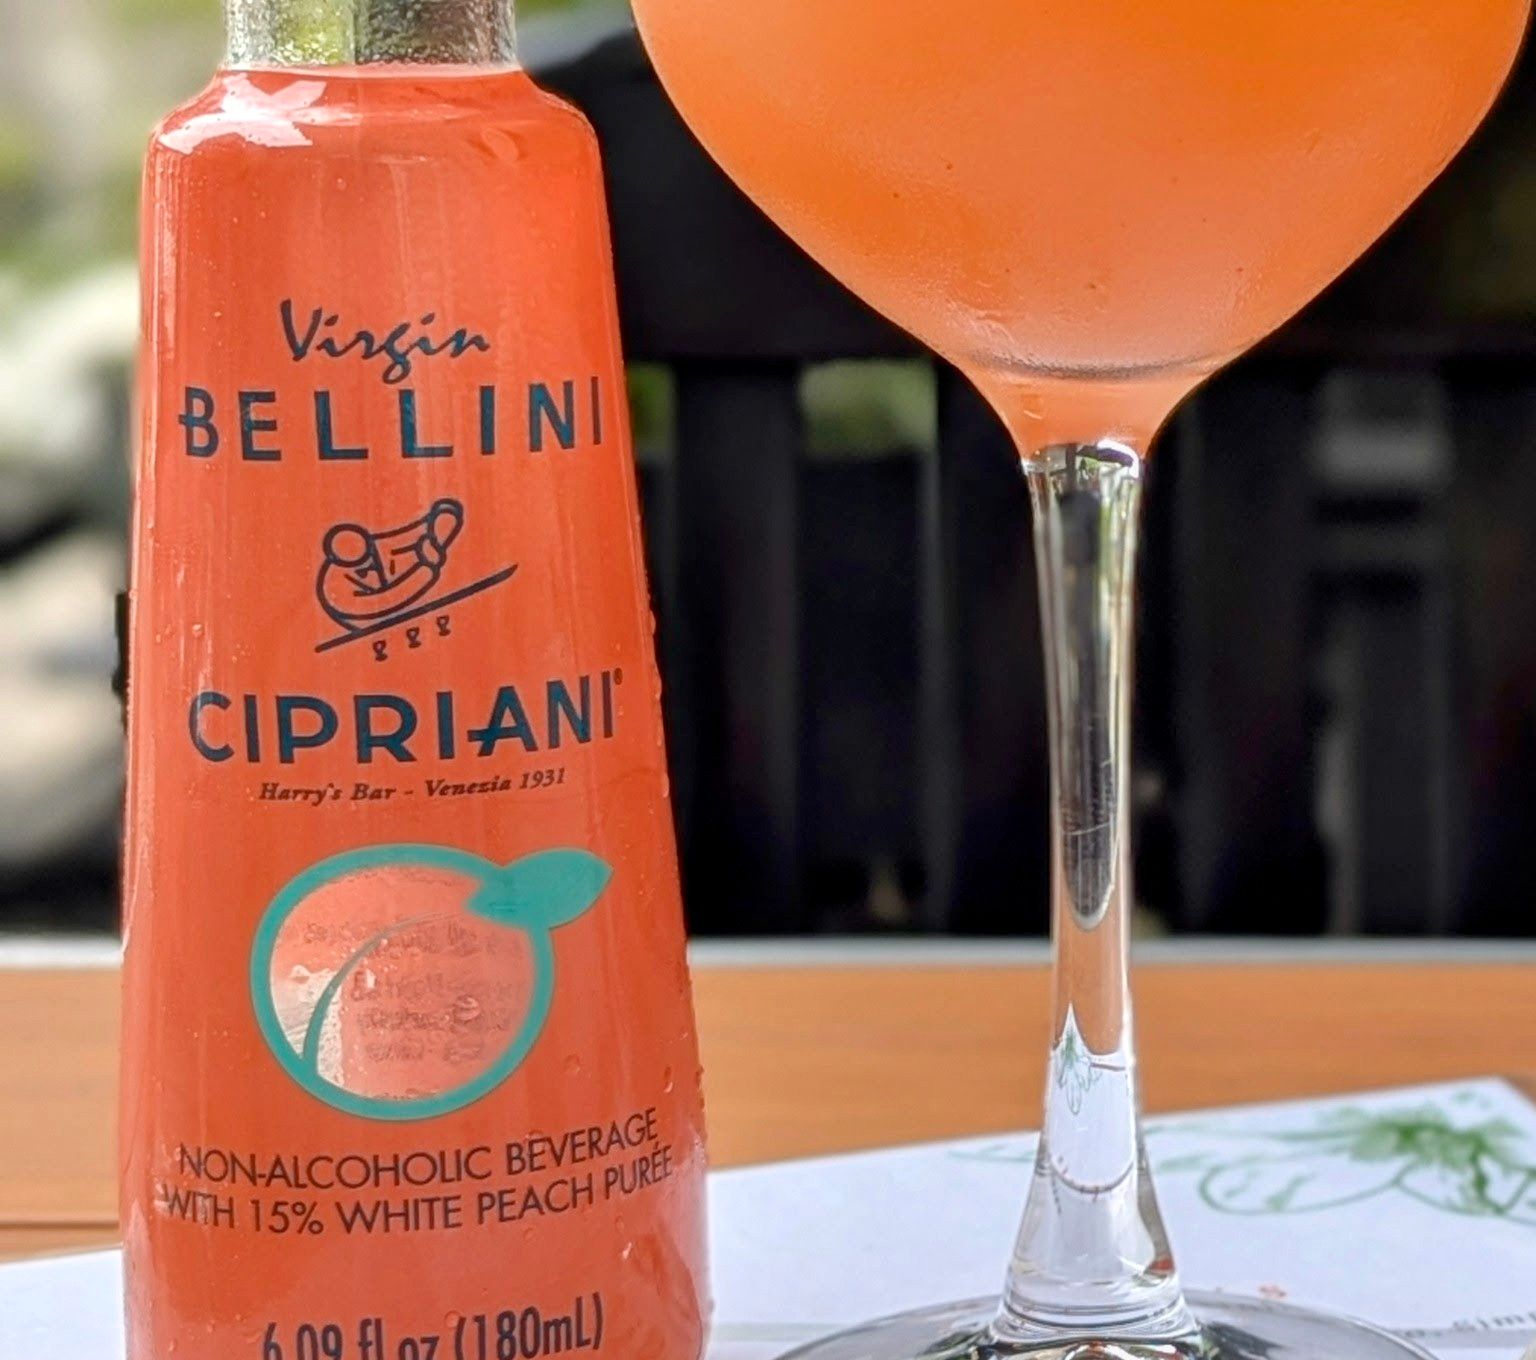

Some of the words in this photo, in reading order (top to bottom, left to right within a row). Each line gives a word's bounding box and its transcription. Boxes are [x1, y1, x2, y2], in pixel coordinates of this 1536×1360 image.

[279, 299, 490, 384] Virgin
[178, 376, 602, 461] BELLINI
[259, 781, 343, 806] Harry's
[350, 782, 397, 802] Bar
[424, 774, 511, 798] Venezia
[519, 767, 565, 791] 1931
[162, 1183, 236, 1229] WITH
[250, 1198, 323, 1235] 15%
[335, 1195, 462, 1233] WHITE
[477, 1173, 594, 1224] PEACH
[604, 1144, 674, 1200] PURÉE
[180, 1143, 492, 1189] NON-ALCOHOLIC
[506, 1107, 659, 1177] BEVERAGE
